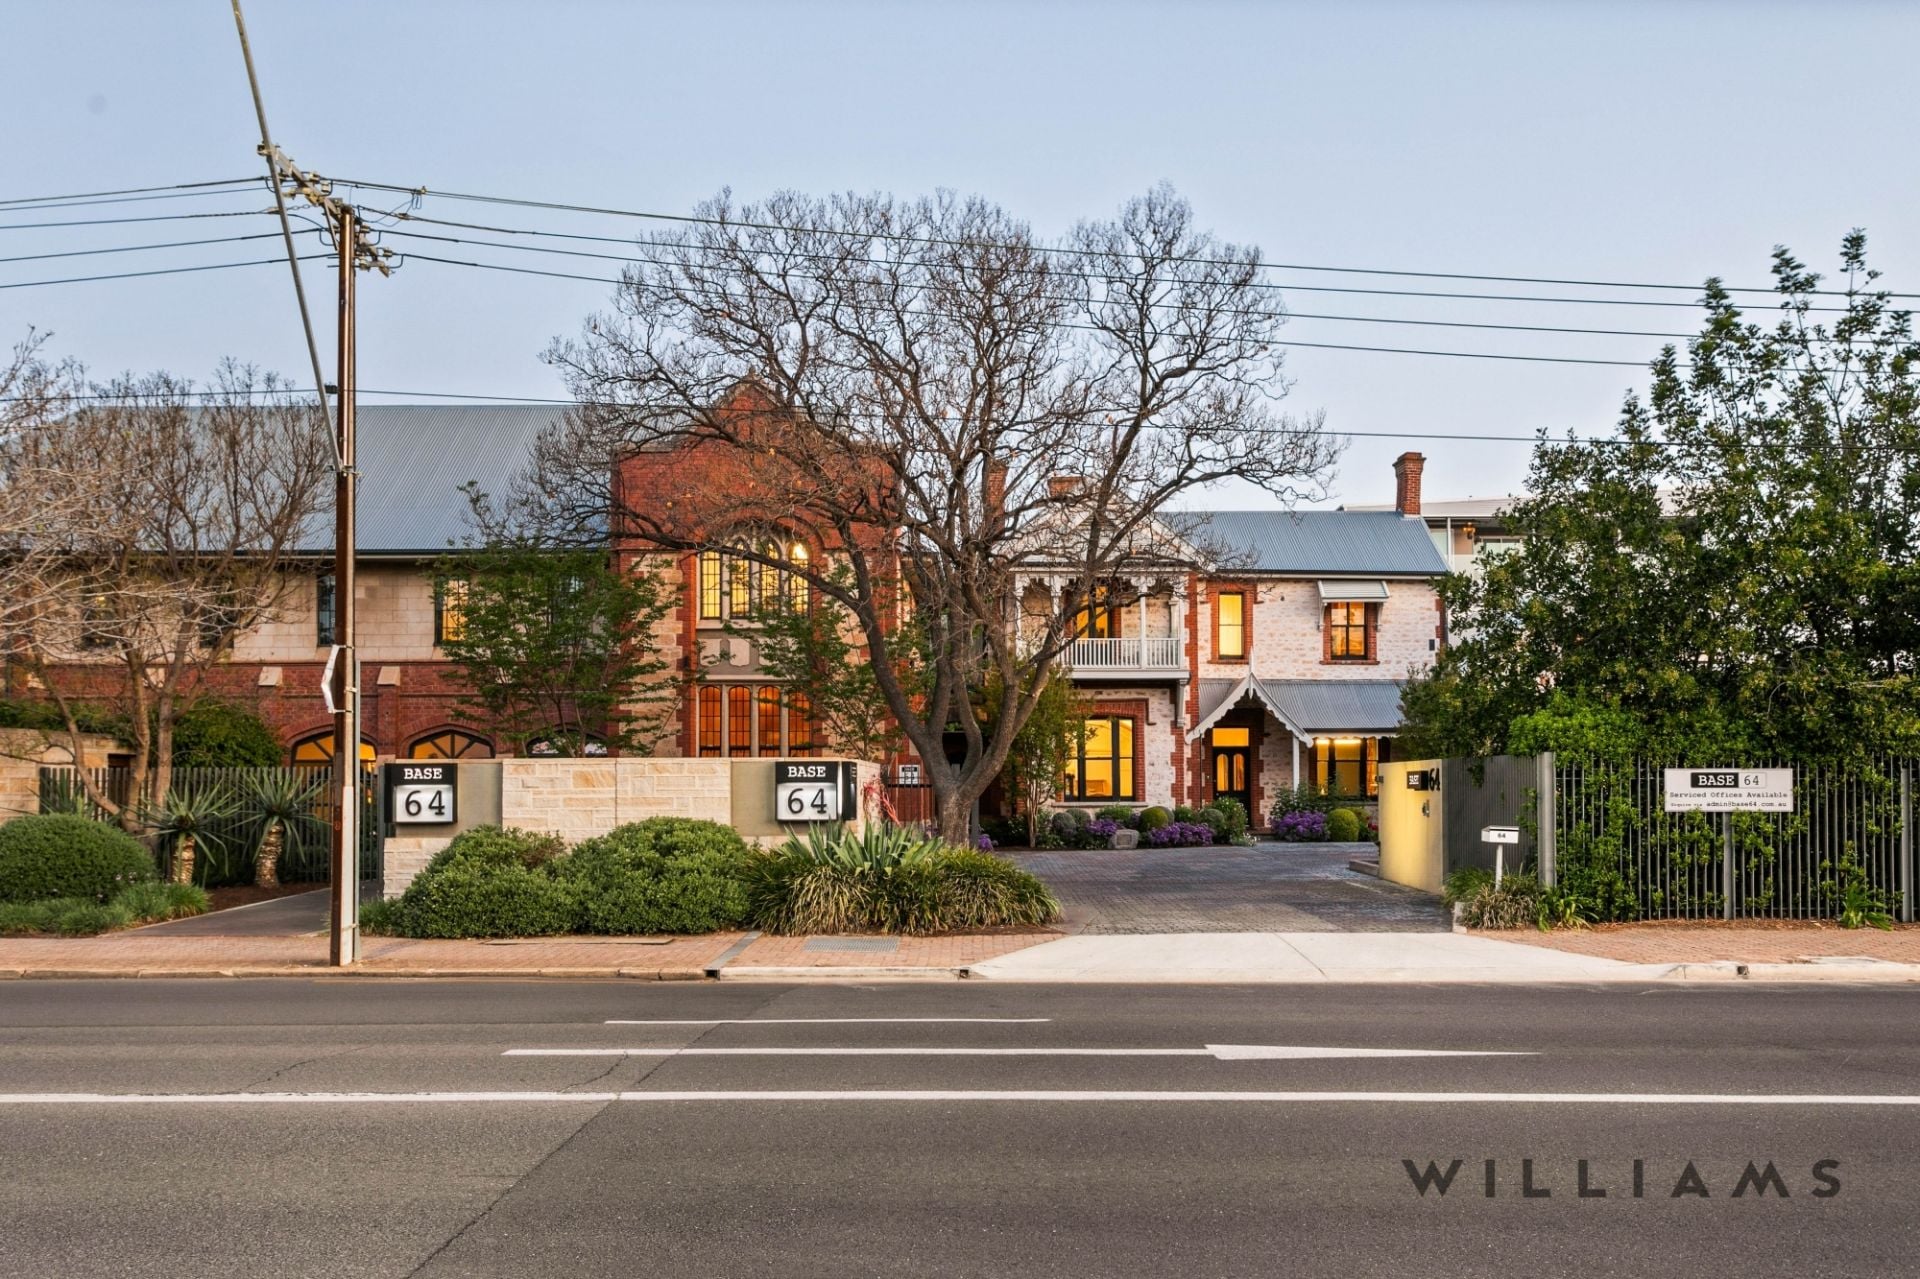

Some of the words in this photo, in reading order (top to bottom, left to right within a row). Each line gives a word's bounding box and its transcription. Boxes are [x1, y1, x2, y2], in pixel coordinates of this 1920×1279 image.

[403, 767, 443, 780] BASE
[787, 766, 826, 778] BASE
[1429, 767, 1441, 792] 64
[1698, 775, 1735, 786] BASE
[1743, 775, 1760, 786] 64
[405, 789, 446, 817] 64
[787, 788, 827, 814] 64
